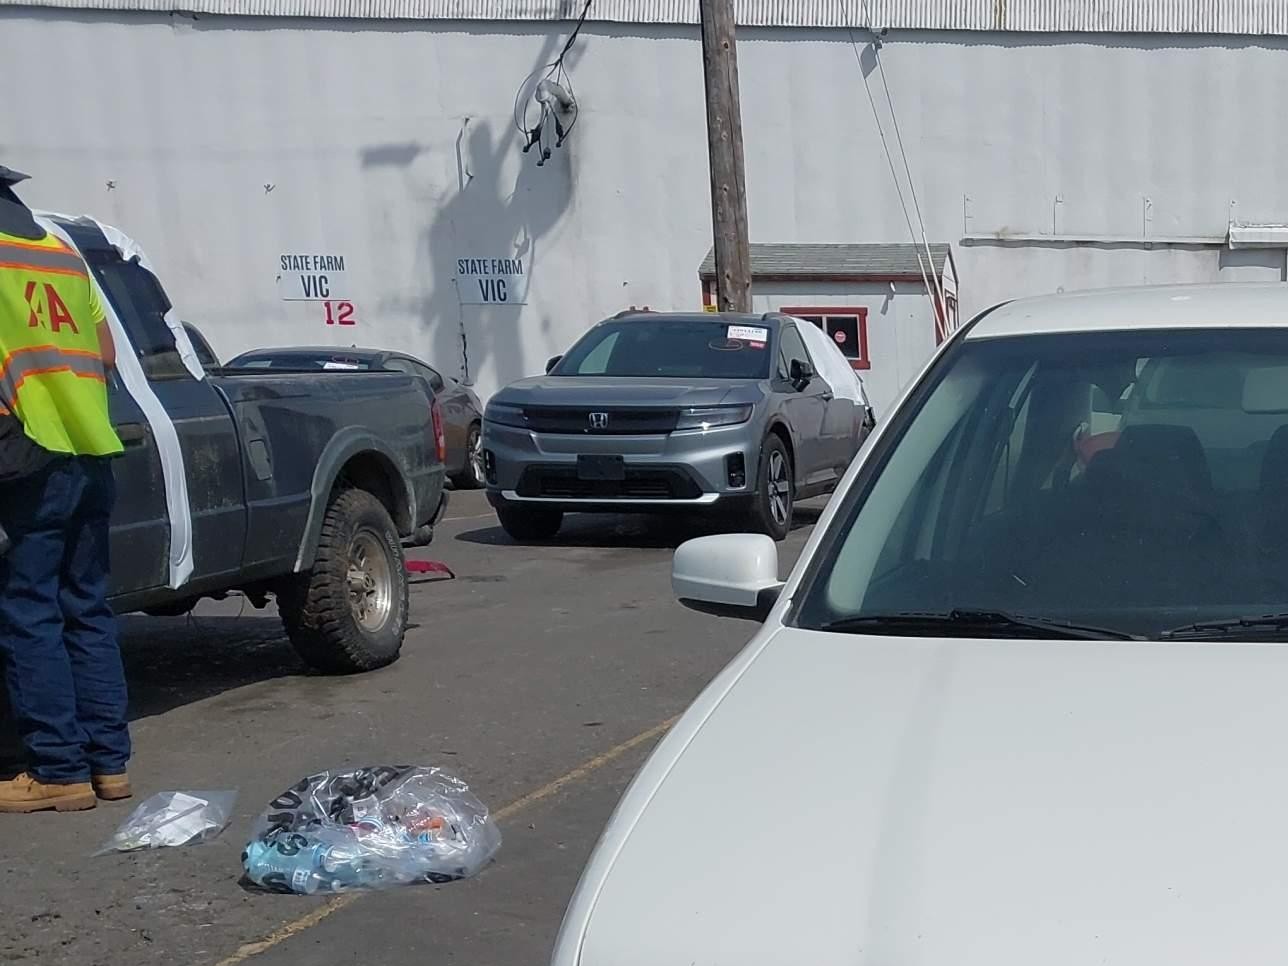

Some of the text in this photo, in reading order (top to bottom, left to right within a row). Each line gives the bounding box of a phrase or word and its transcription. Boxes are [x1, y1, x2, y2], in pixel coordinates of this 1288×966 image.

[280, 254, 345, 272] STATE FARM
[457, 258, 523, 276] STATE FARM
[300, 274, 330, 298] VIC
[478, 278, 508, 303] VIC
[323, 301, 356, 326] 12
